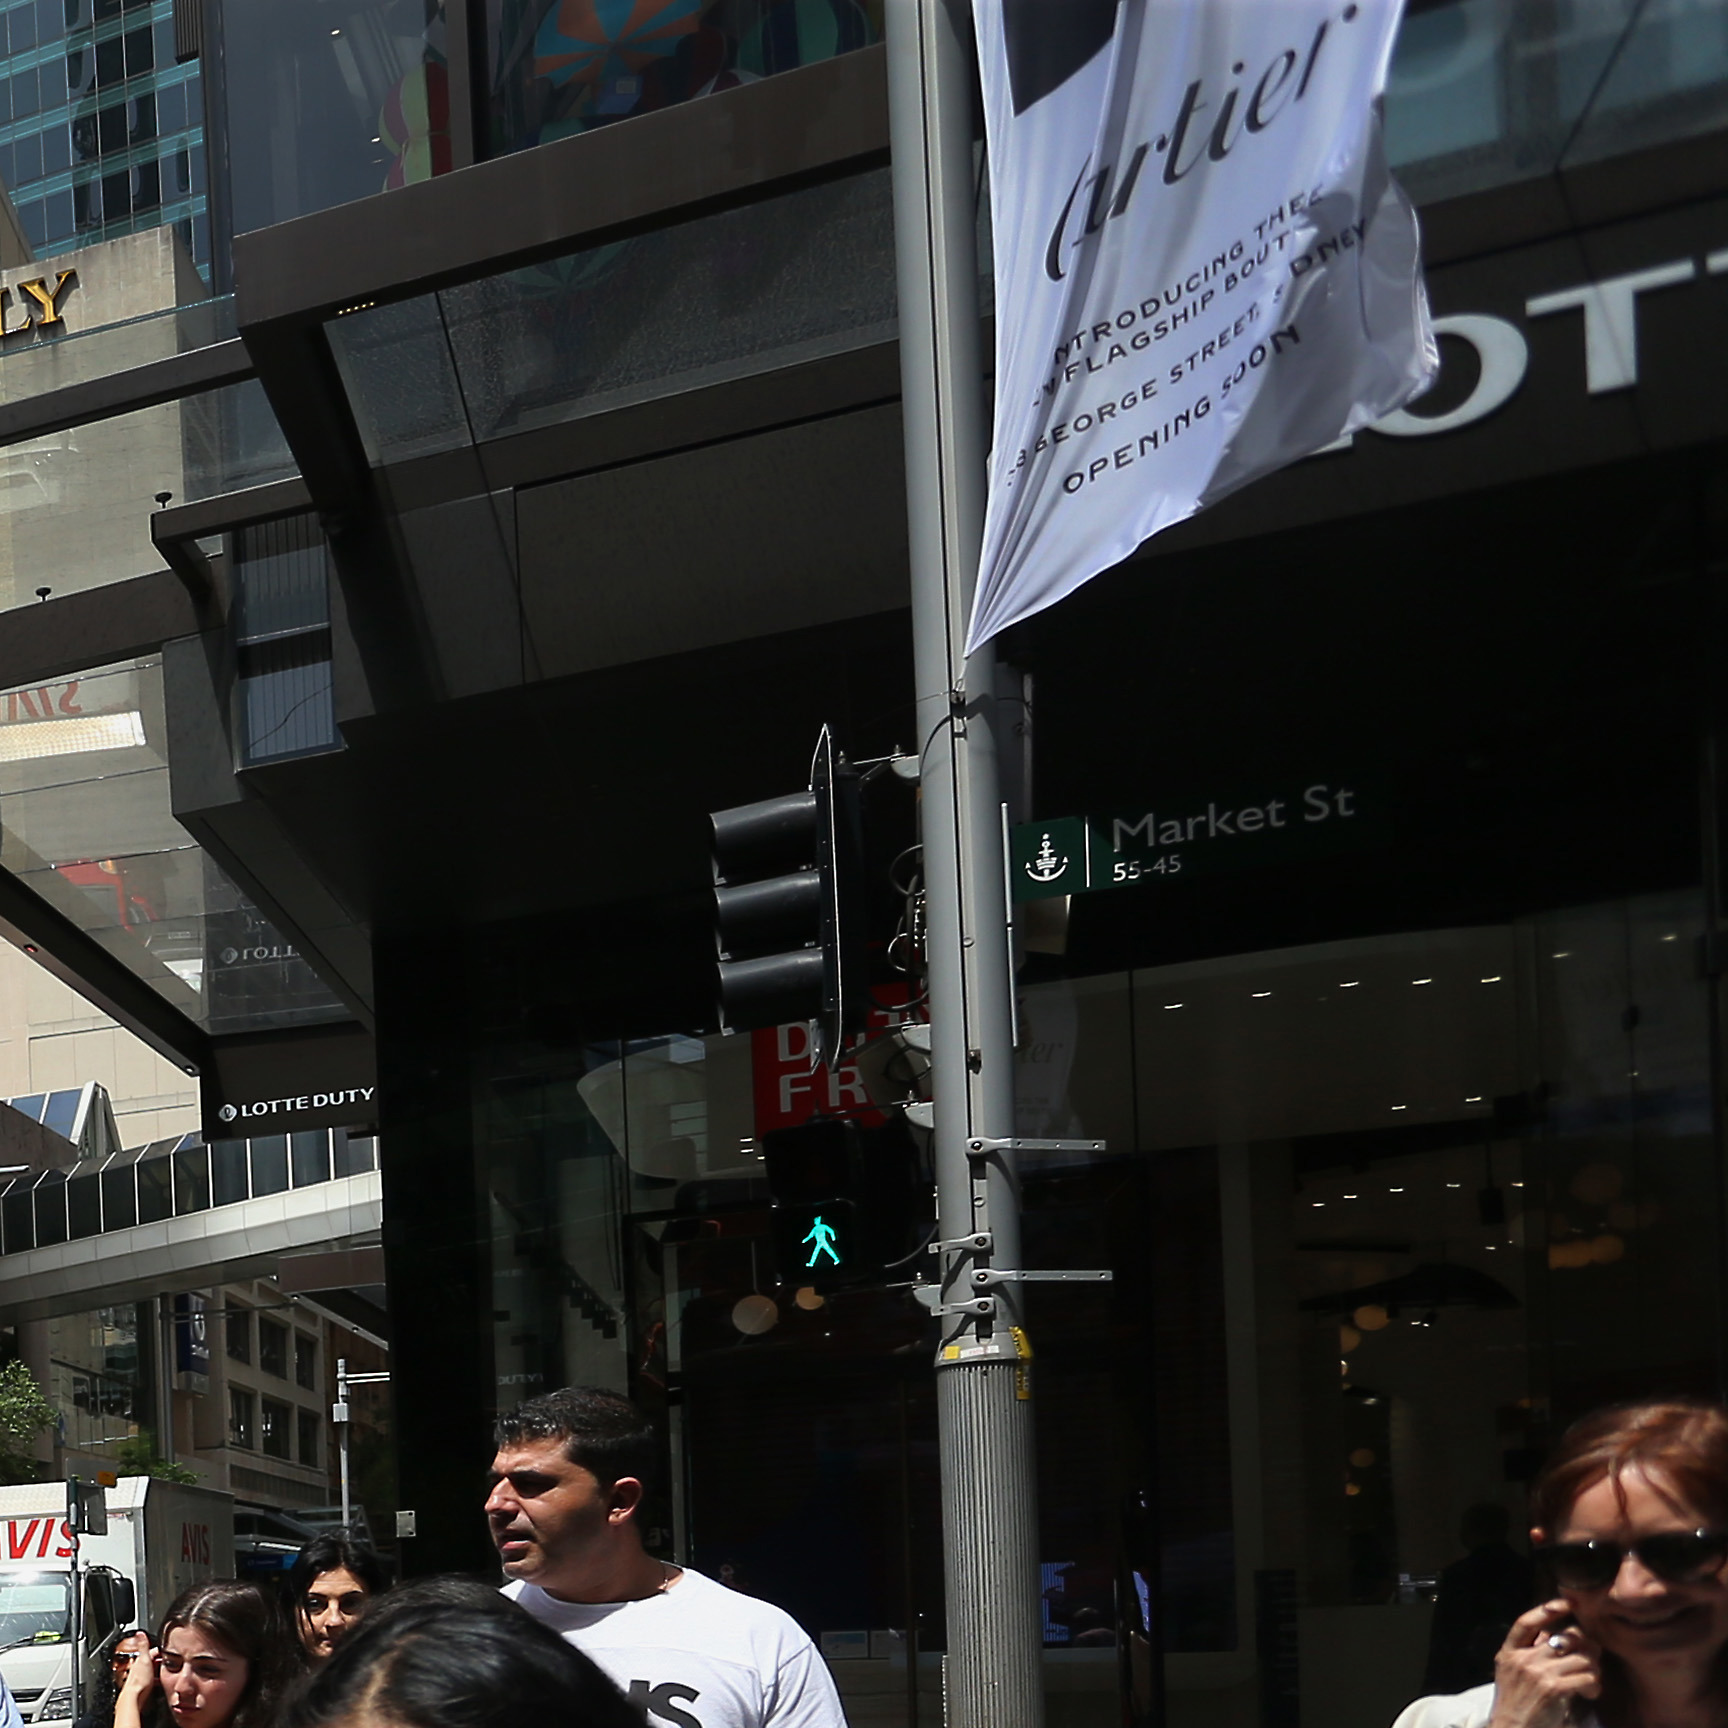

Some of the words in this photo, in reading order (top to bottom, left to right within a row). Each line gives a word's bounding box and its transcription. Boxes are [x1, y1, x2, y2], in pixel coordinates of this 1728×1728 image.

[1034, 379, 1158, 453] GEORGE
[1273, 217, 1366, 304] SDNEY
[1064, 289, 1215, 383] FLAGSHIP
[1225, 231, 1290, 294] BOUT
[1063, 396, 1211, 494] OPENING
[1112, 798, 1286, 853] Market
[1303, 784, 1356, 823] St
[1112, 854, 1182, 882] 55-45
[241, 1095, 309, 1118] LOTTE
[313, 1087, 375, 1109] DUTY
[779, 1066, 869, 1113] FR
[181, 1521, 211, 1566] AVIS
